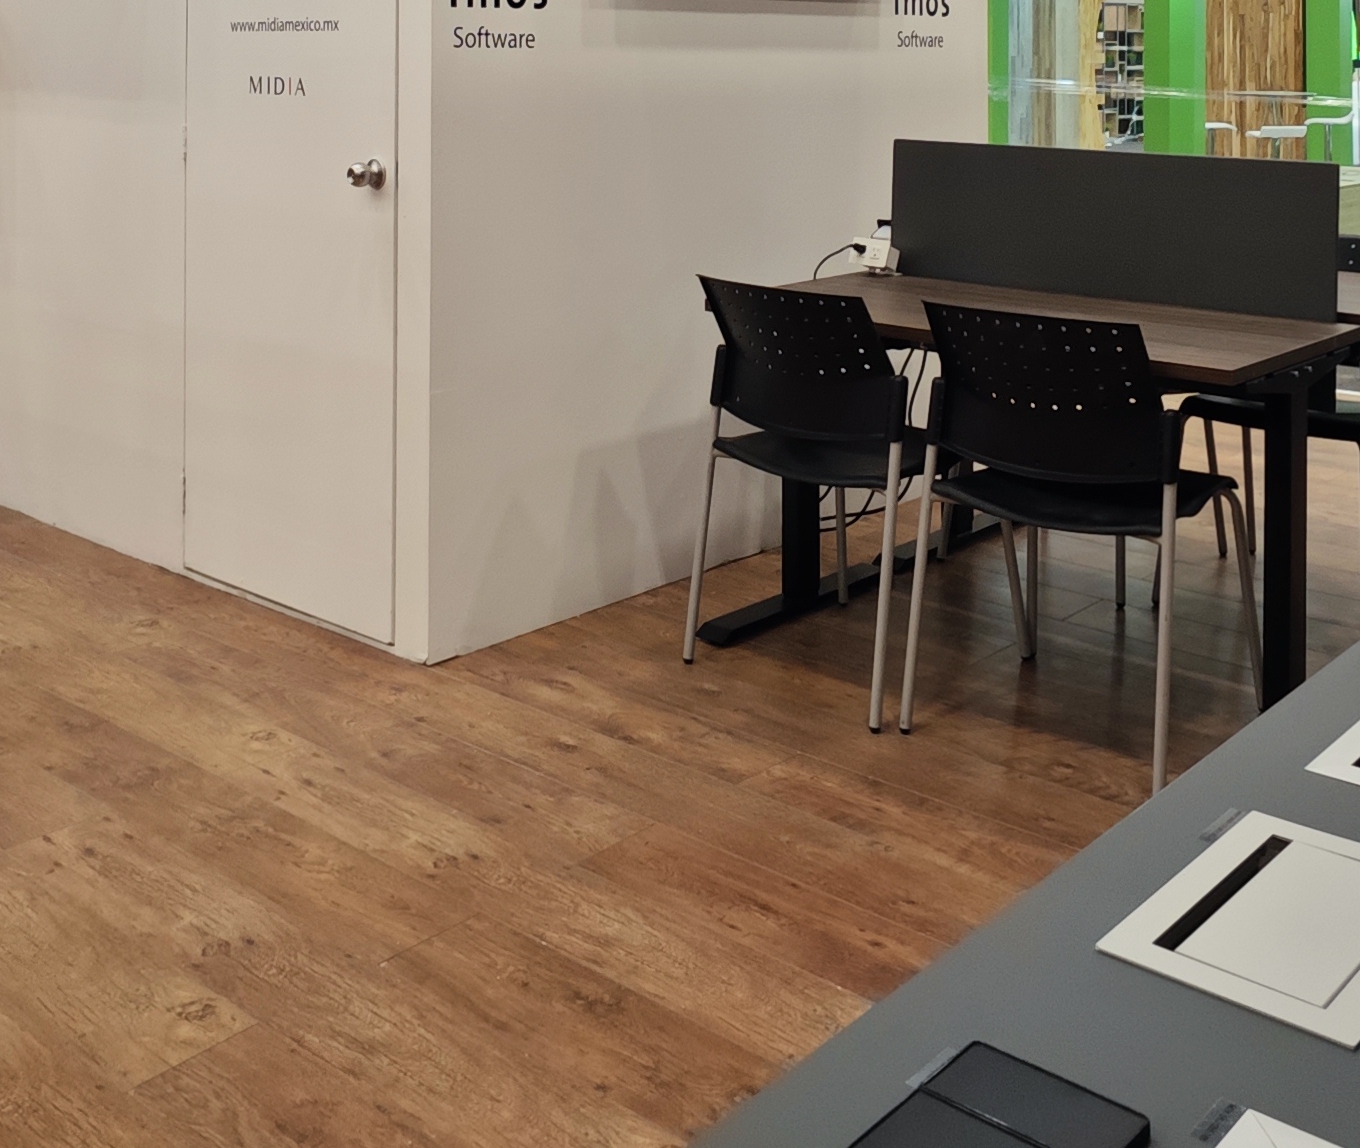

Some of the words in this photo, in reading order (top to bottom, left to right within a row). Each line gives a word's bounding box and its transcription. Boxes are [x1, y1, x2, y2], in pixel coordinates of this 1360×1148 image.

[230, 17, 340, 33] www.midiamexico.mx
[453, 26, 536, 49] Software
[896, 30, 945, 49] Software
[248, 75, 307, 97] MIDIA
